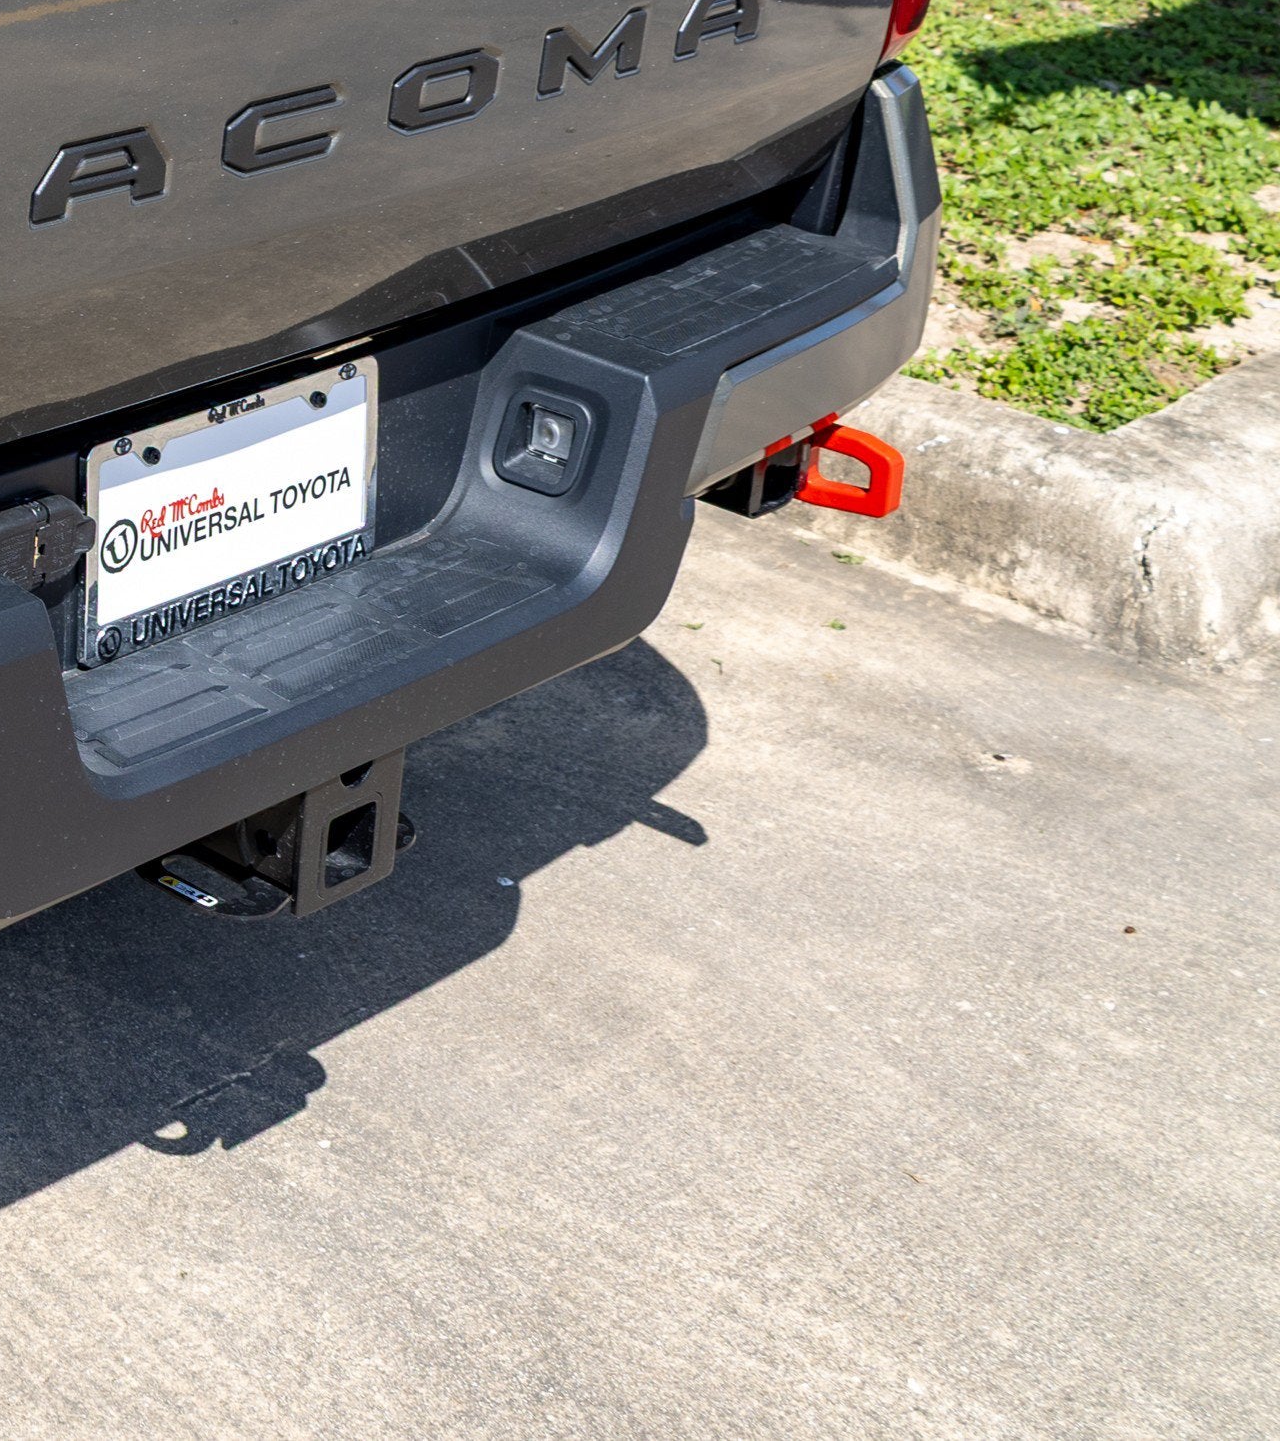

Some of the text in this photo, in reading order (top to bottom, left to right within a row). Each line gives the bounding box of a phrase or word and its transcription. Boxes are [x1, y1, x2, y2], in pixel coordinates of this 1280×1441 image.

[140, 497, 265, 562] UNIVERSAL
[269, 466, 352, 514] TOYOTA
[140, 505, 167, 539] Red
[130, 534, 367, 646] UNIVERSAL TOYOTA
